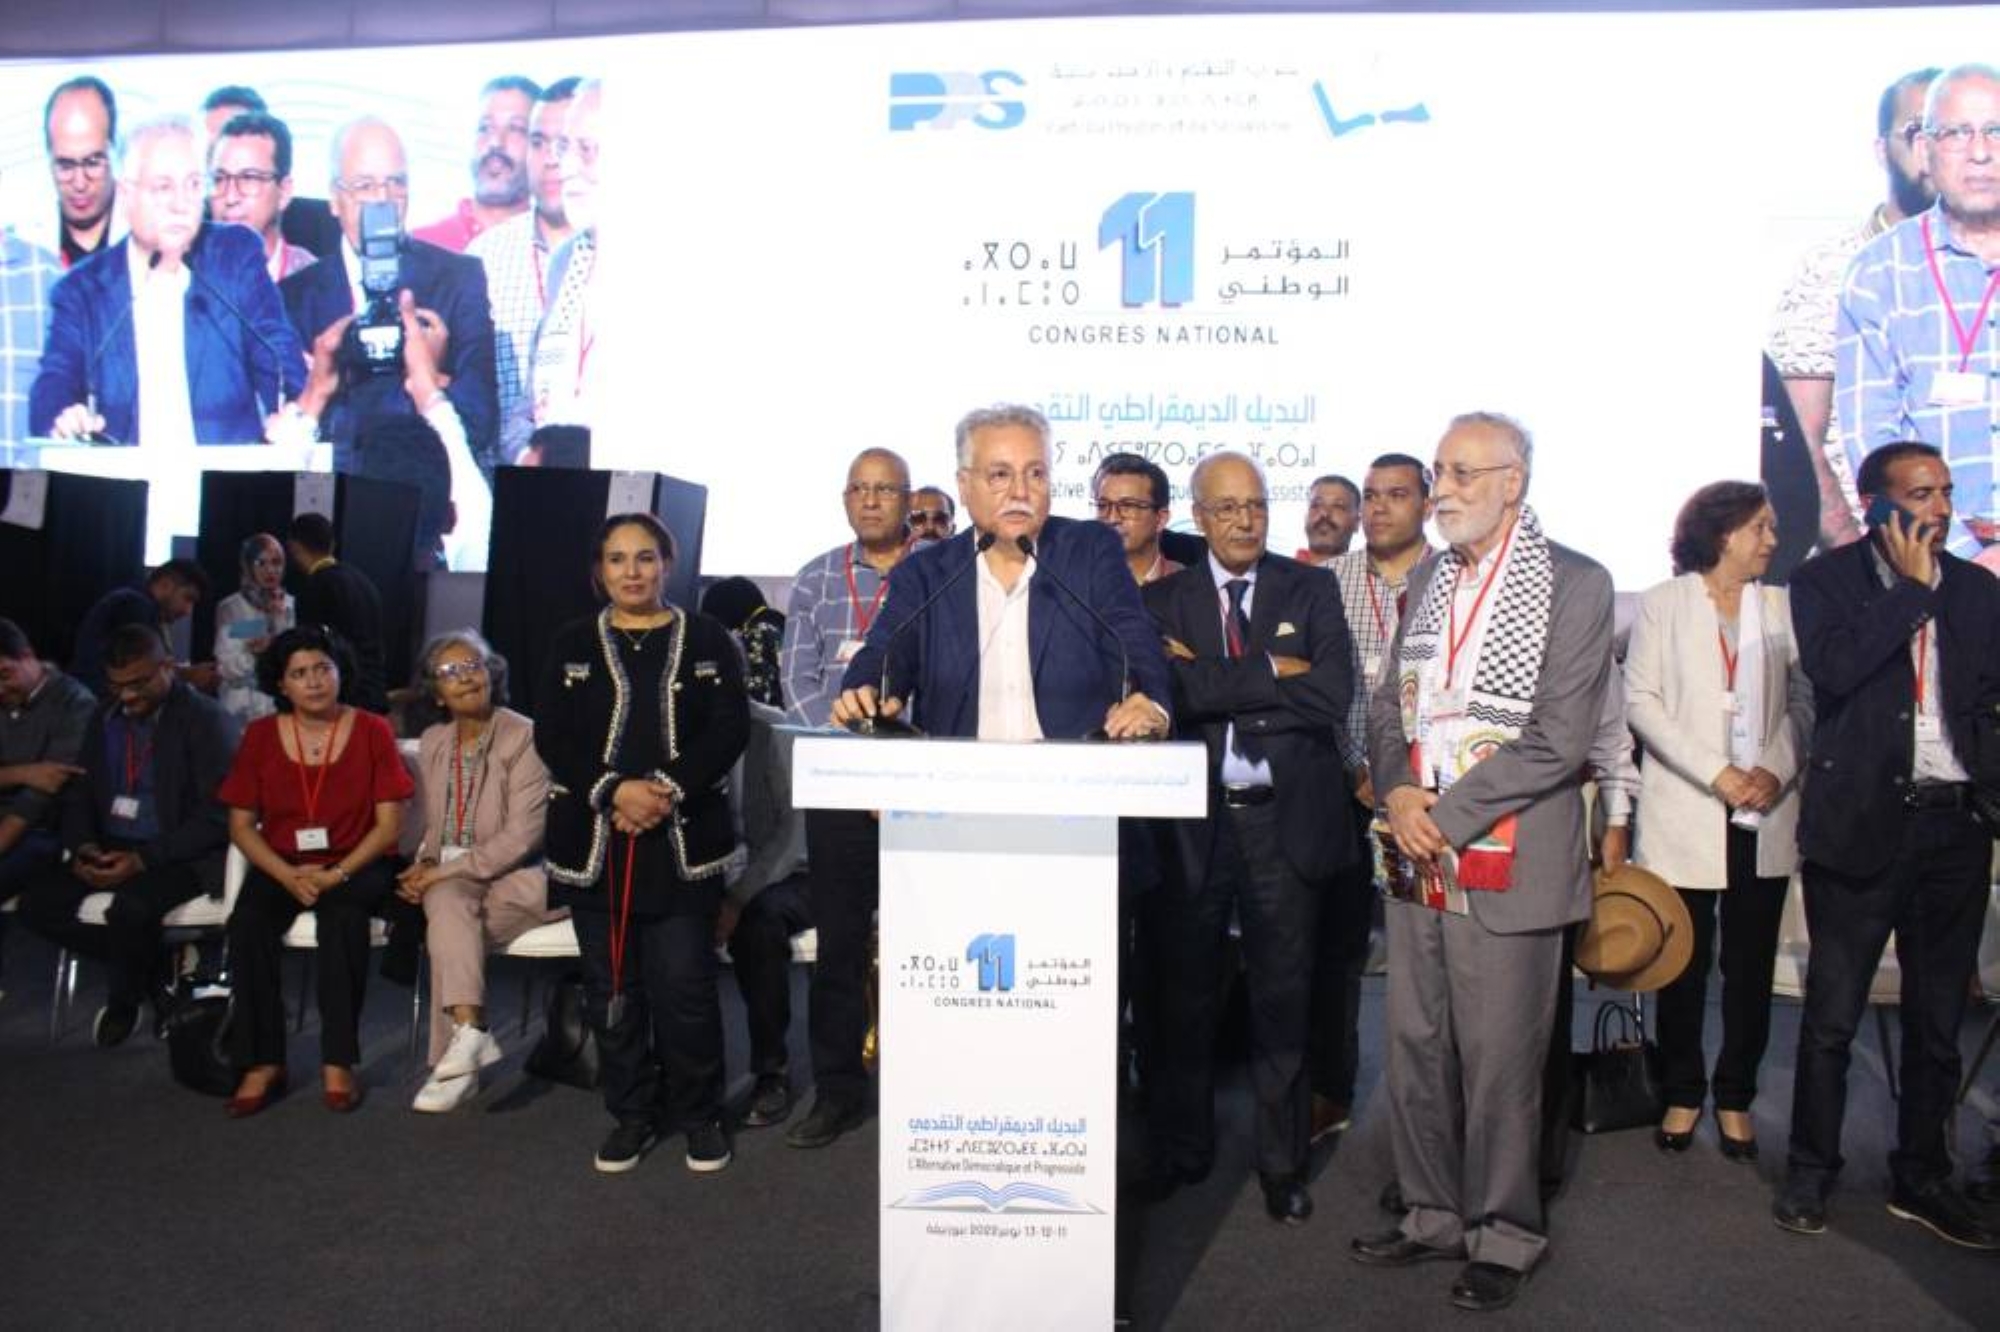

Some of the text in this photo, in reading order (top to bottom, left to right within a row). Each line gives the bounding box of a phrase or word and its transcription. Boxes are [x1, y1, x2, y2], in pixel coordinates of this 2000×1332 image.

[1221, 239, 1350, 265] المؤتمر
[1218, 275, 1350, 305] الوطني
[1156, 324, 1279, 345] NATIONAL
[1097, 392, 1237, 431] الديمقراطي
[1244, 394, 1316, 430] البديل
[1027, 957, 1091, 972] المؤتمر
[1026, 974, 1091, 989] الوطني
[996, 996, 1057, 1009] NATIONAL
[908, 1113, 1087, 1138] البديل الديمقراطي التقدمي
